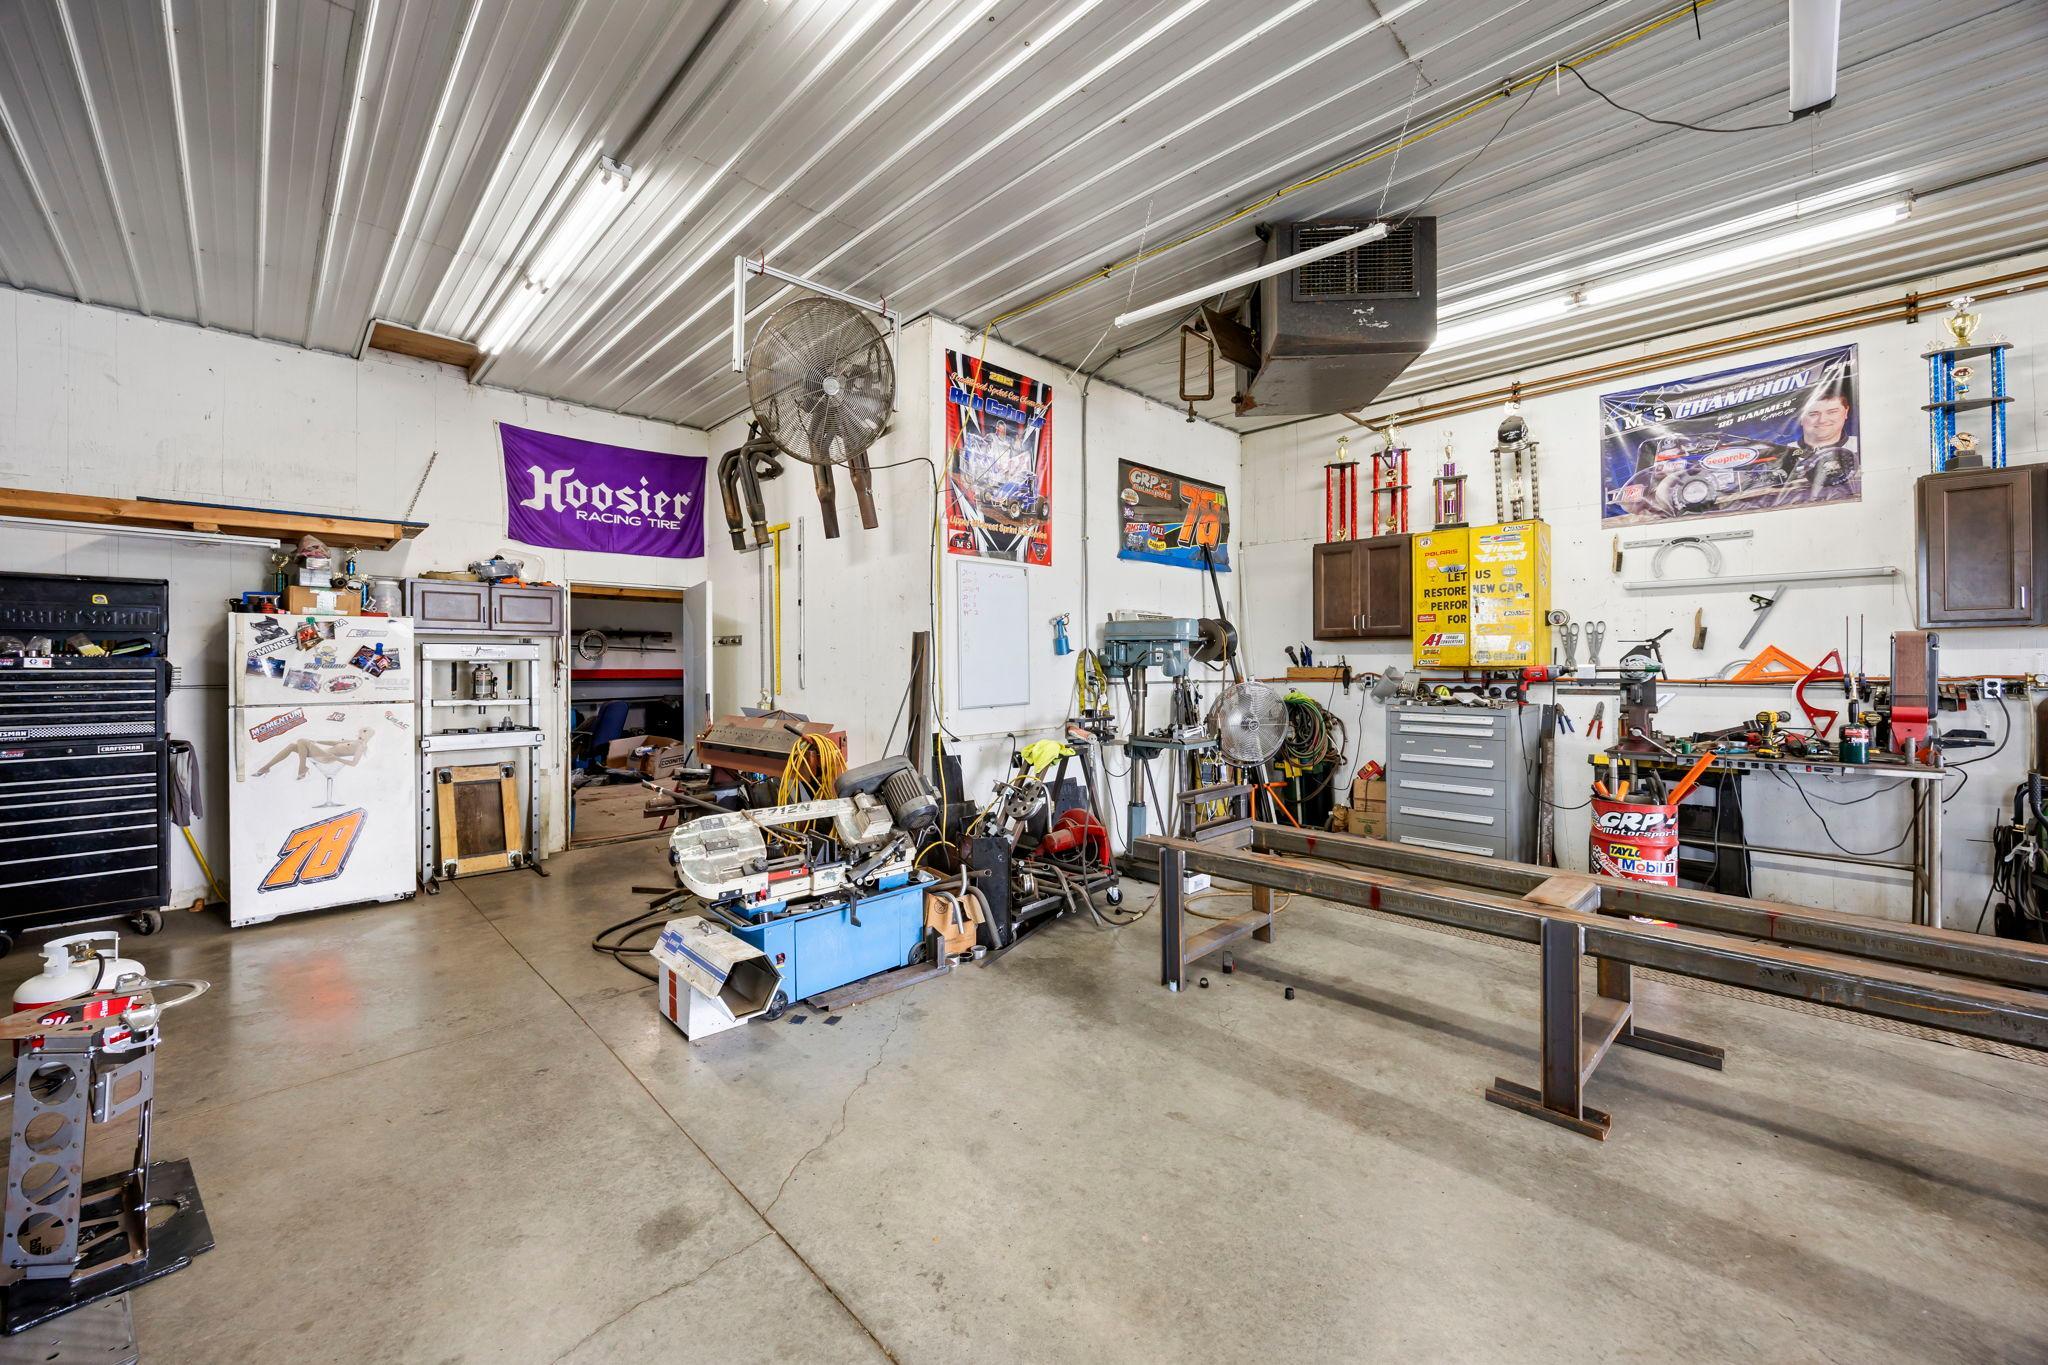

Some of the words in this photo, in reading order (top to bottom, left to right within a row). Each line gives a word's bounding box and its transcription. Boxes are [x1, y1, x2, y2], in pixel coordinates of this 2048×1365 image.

[949, 386, 984, 411] Rob
[1675, 371, 1809, 420] CHAMPION
[1706, 452, 1751, 464] Geoprobe
[1130, 470, 1159, 488] GRP
[520, 465, 692, 520] Hoosier
[576, 510, 642, 526] RACING
[648, 518, 681, 530] TIRE
[1424, 549, 1458, 557] POLARIS
[1447, 572, 1468, 583] LET
[1475, 569, 1492, 579] US
[1424, 586, 1467, 598] RESTORE
[1473, 584, 1496, 594] NEW
[1499, 582, 1524, 593] CAR
[1431, 600, 1468, 611] PERFOR
[6, 608, 152, 625] CRAFTSMAN
[1447, 615, 1467, 624] FOR
[251, 710, 303, 736] MOMENTUM
[1600, 812, 1665, 831] GRP
[257, 808, 369, 894] 78
[1622, 858, 1662, 873] Mobil
[1665, 862, 1674, 873] 1
